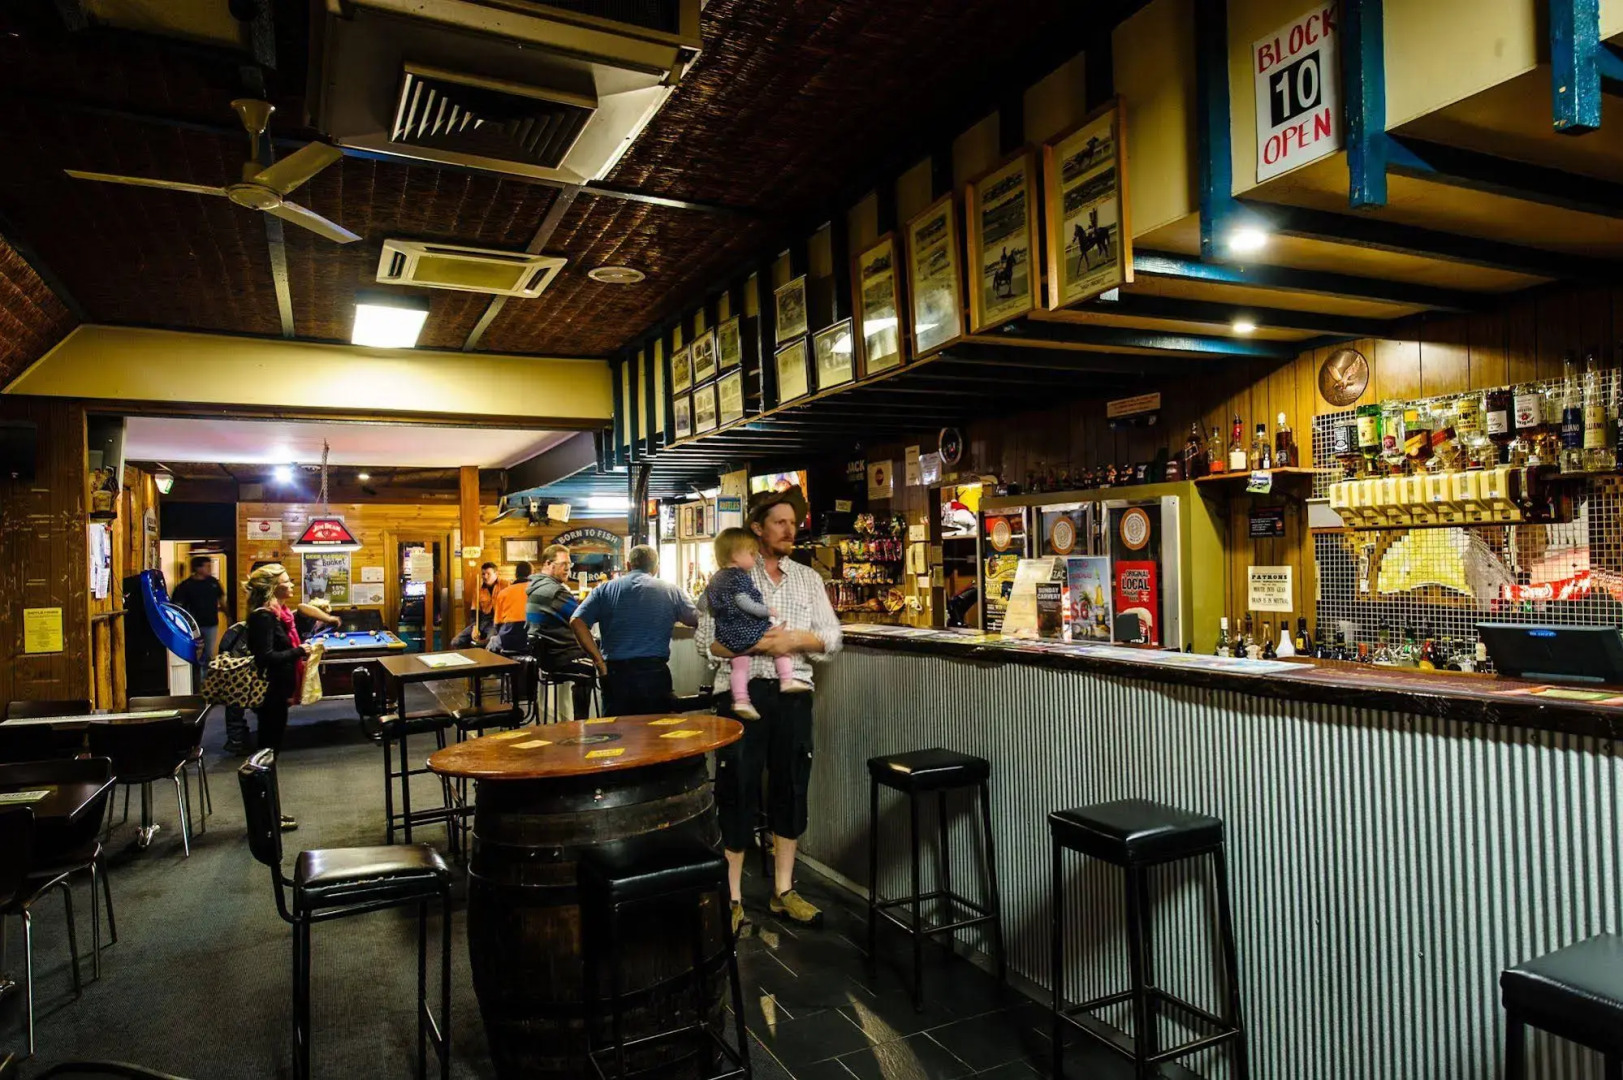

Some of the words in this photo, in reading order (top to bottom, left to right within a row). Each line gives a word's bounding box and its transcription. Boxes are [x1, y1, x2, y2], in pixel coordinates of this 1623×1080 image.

[1258, 4, 1338, 73] BLOCK
[1275, 58, 1319, 118] 10
[1263, 108, 1331, 165] OPEN
[558, 530, 583, 545] BORN
[597, 530, 619, 544] FISH
[1121, 578, 1150, 590] LOCAL
[1070, 599, 1089, 621] $6
